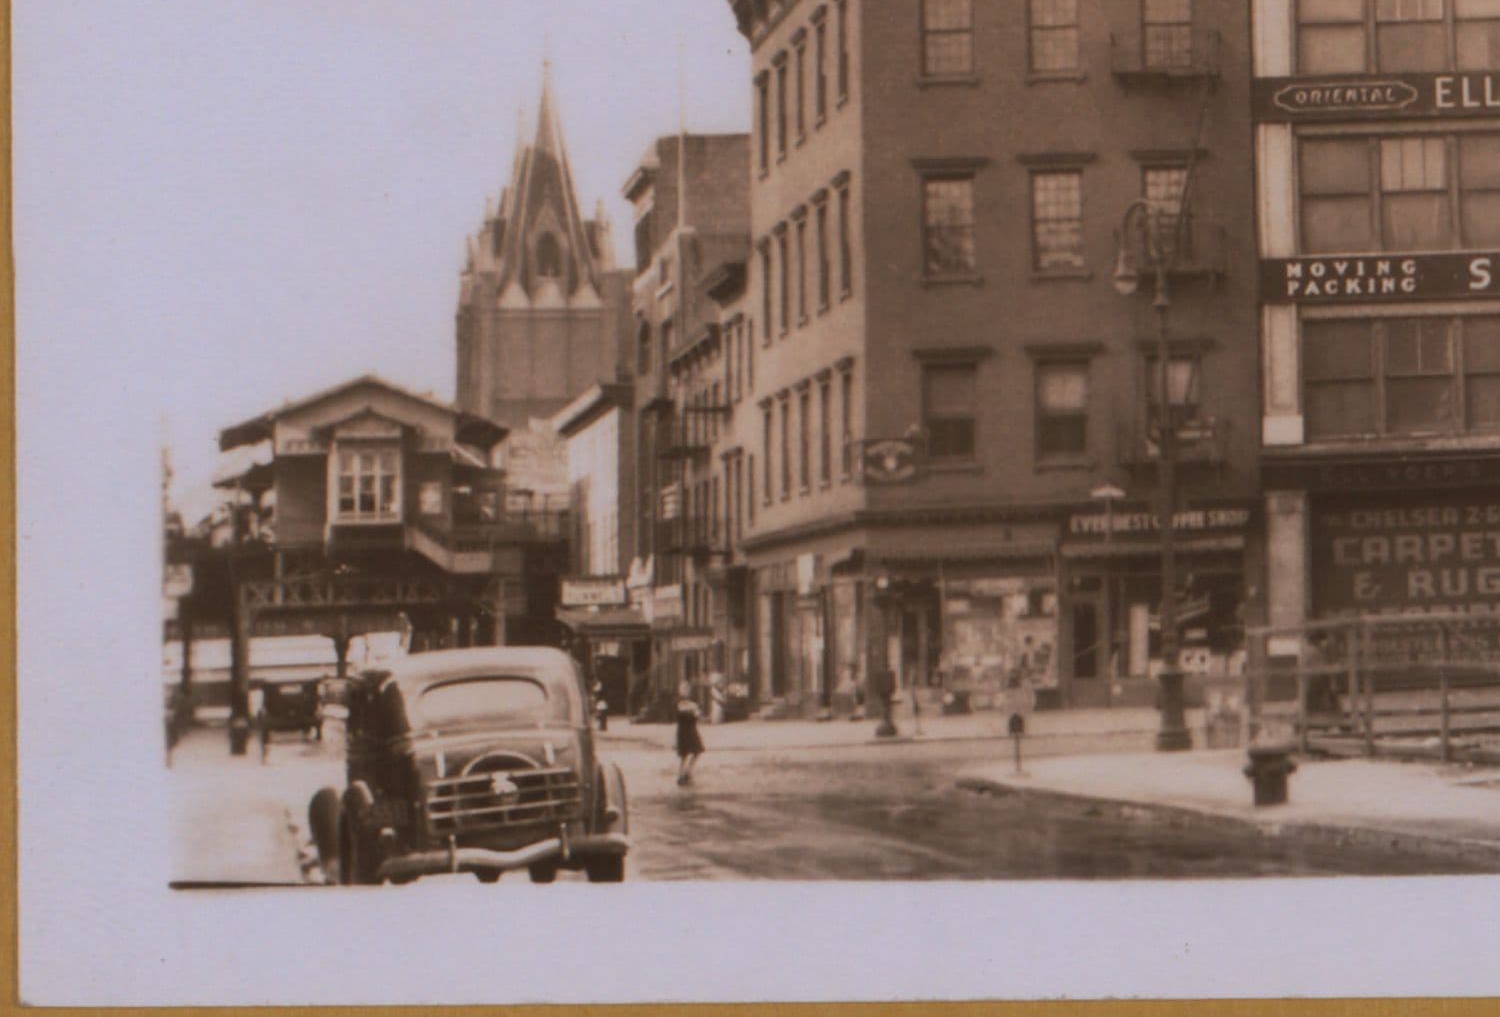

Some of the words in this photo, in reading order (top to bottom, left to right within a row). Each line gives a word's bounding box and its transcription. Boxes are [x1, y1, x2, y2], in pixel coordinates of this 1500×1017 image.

[1294, 86, 1396, 104] ORIENTAL
[1286, 259, 1417, 277] MOVING
[1287, 277, 1417, 296] PACKING
[1349, 506, 1459, 528] CHELSEA
[1353, 571, 1382, 600] &
